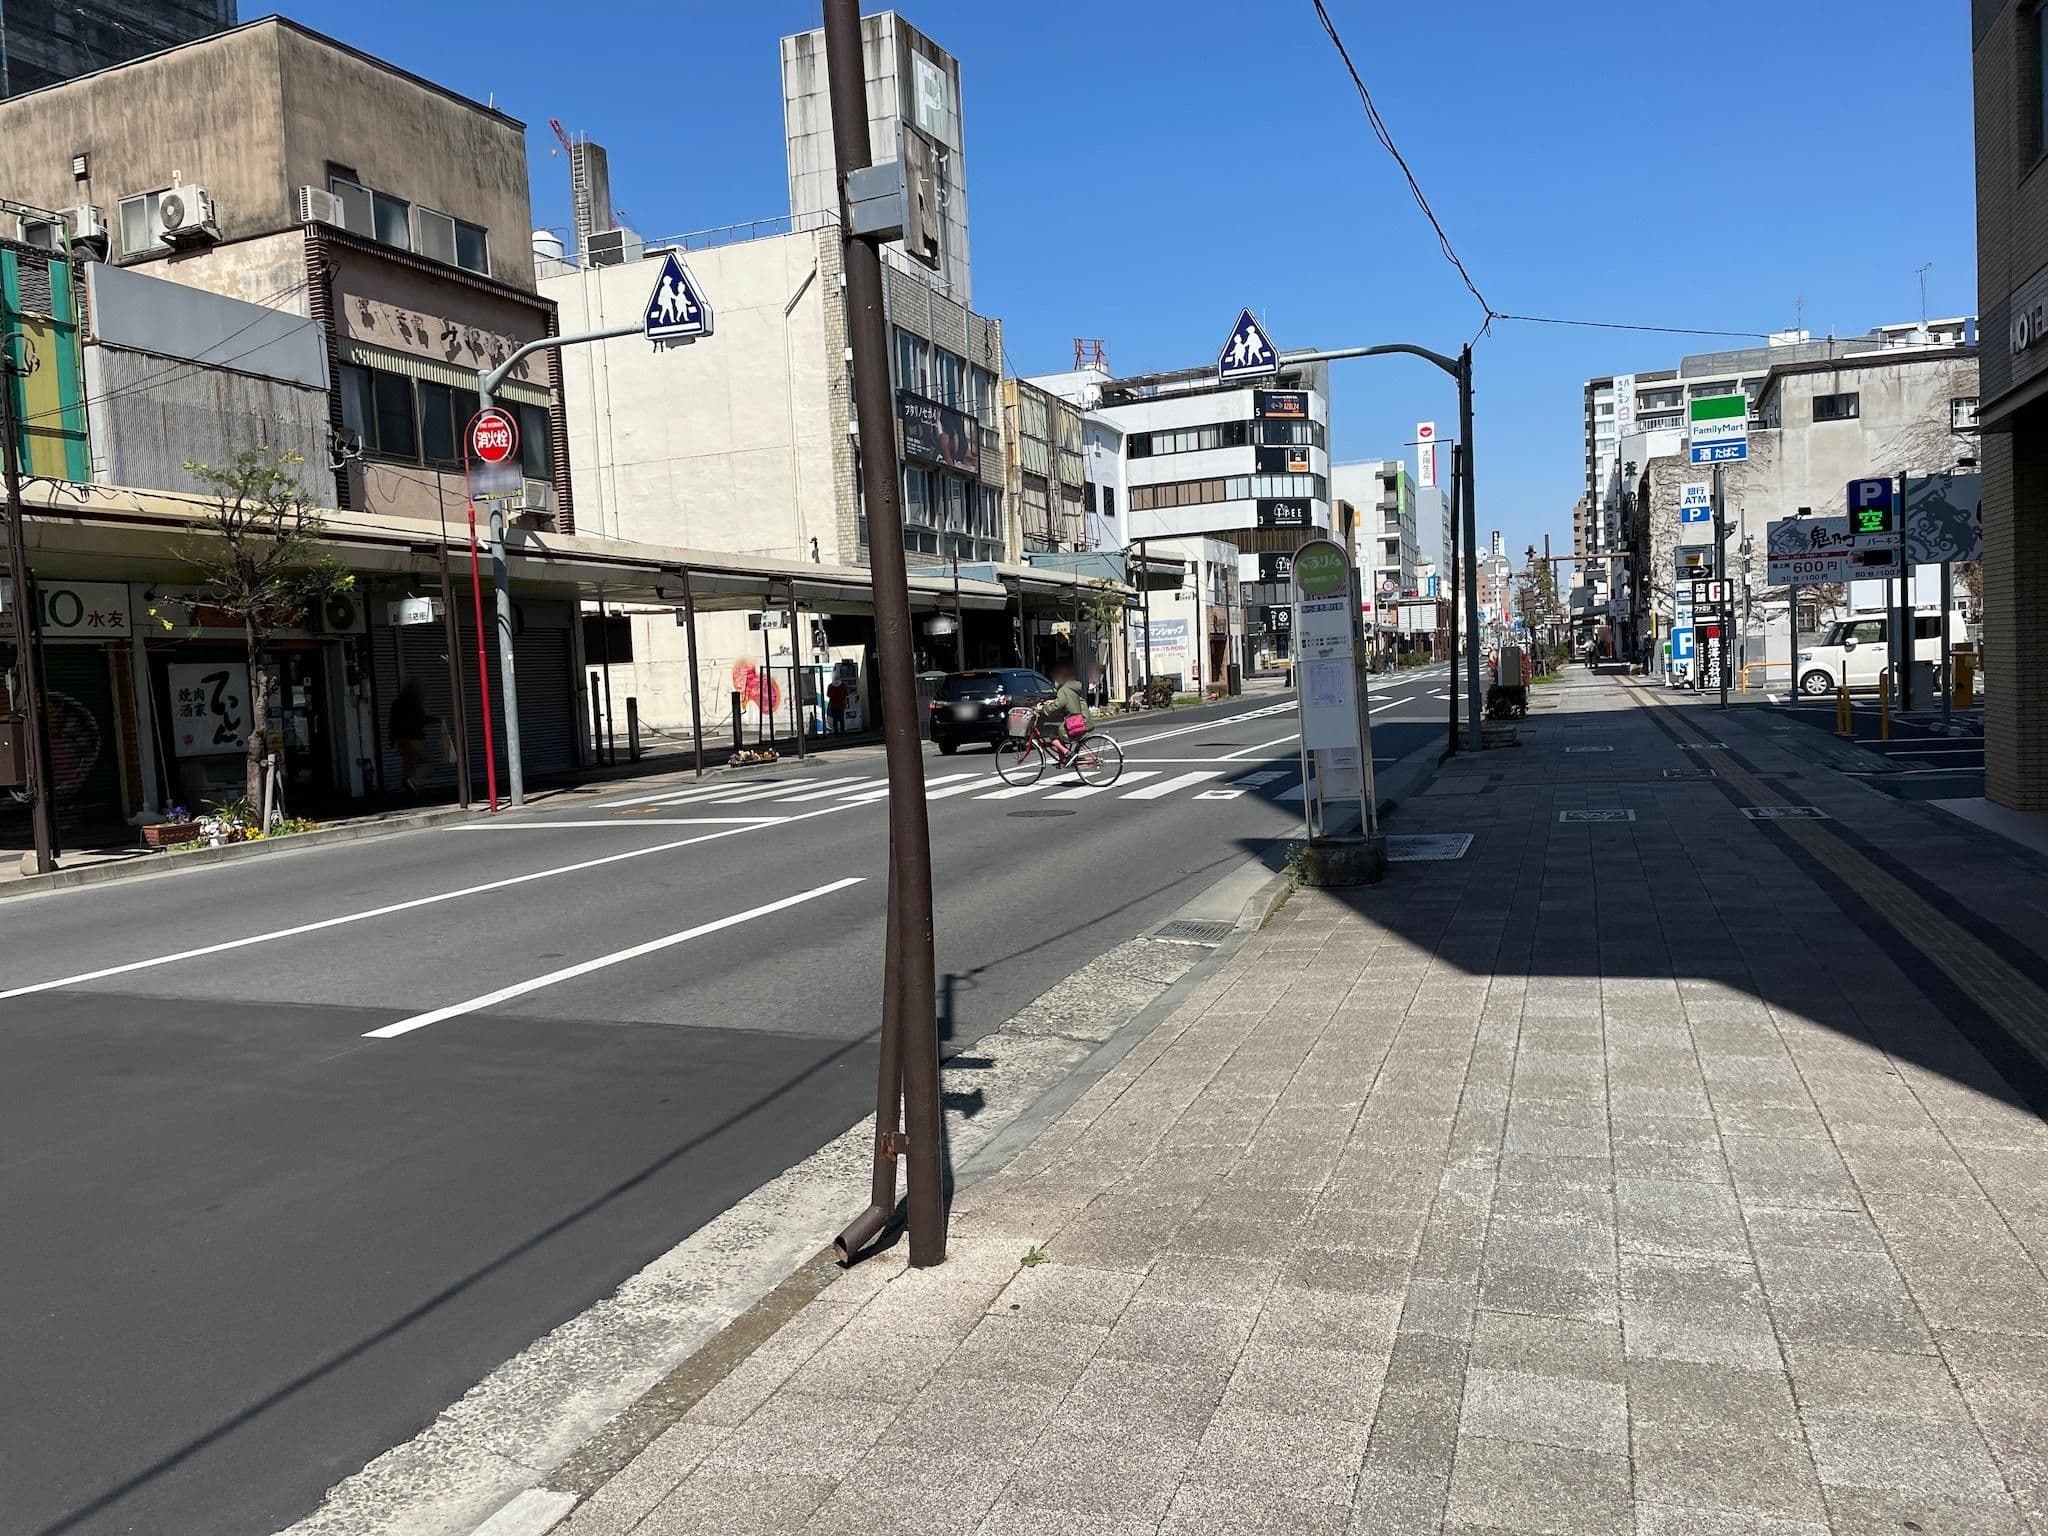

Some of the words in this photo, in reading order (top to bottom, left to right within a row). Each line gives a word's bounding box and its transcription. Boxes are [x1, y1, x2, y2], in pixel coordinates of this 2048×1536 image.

[917, 60, 942, 126] P
[1255, 407, 1261, 417] 5
[1693, 423, 1743, 435] FamilyMart
[476, 429, 508, 449] 消火栓
[1699, 448, 1712, 461] 酒
[1714, 447, 1739, 458] たばこ
[1256, 462, 1262, 471] 4
[1687, 487, 1704, 496] 銀行
[1859, 483, 1883, 506] P
[1684, 496, 1707, 505] ATM
[1258, 516, 1264, 525] 3
[1689, 509, 1701, 521] P
[1859, 510, 1883, 532] 空
[1867, 537, 1900, 546] パーキン
[1261, 570, 1266, 578] 2
[88, 610, 125, 628] 水友
[1138, 625, 1185, 637] アマンショップ
[178, 688, 206, 702] 焼肉
[179, 703, 208, 718] 酒家
